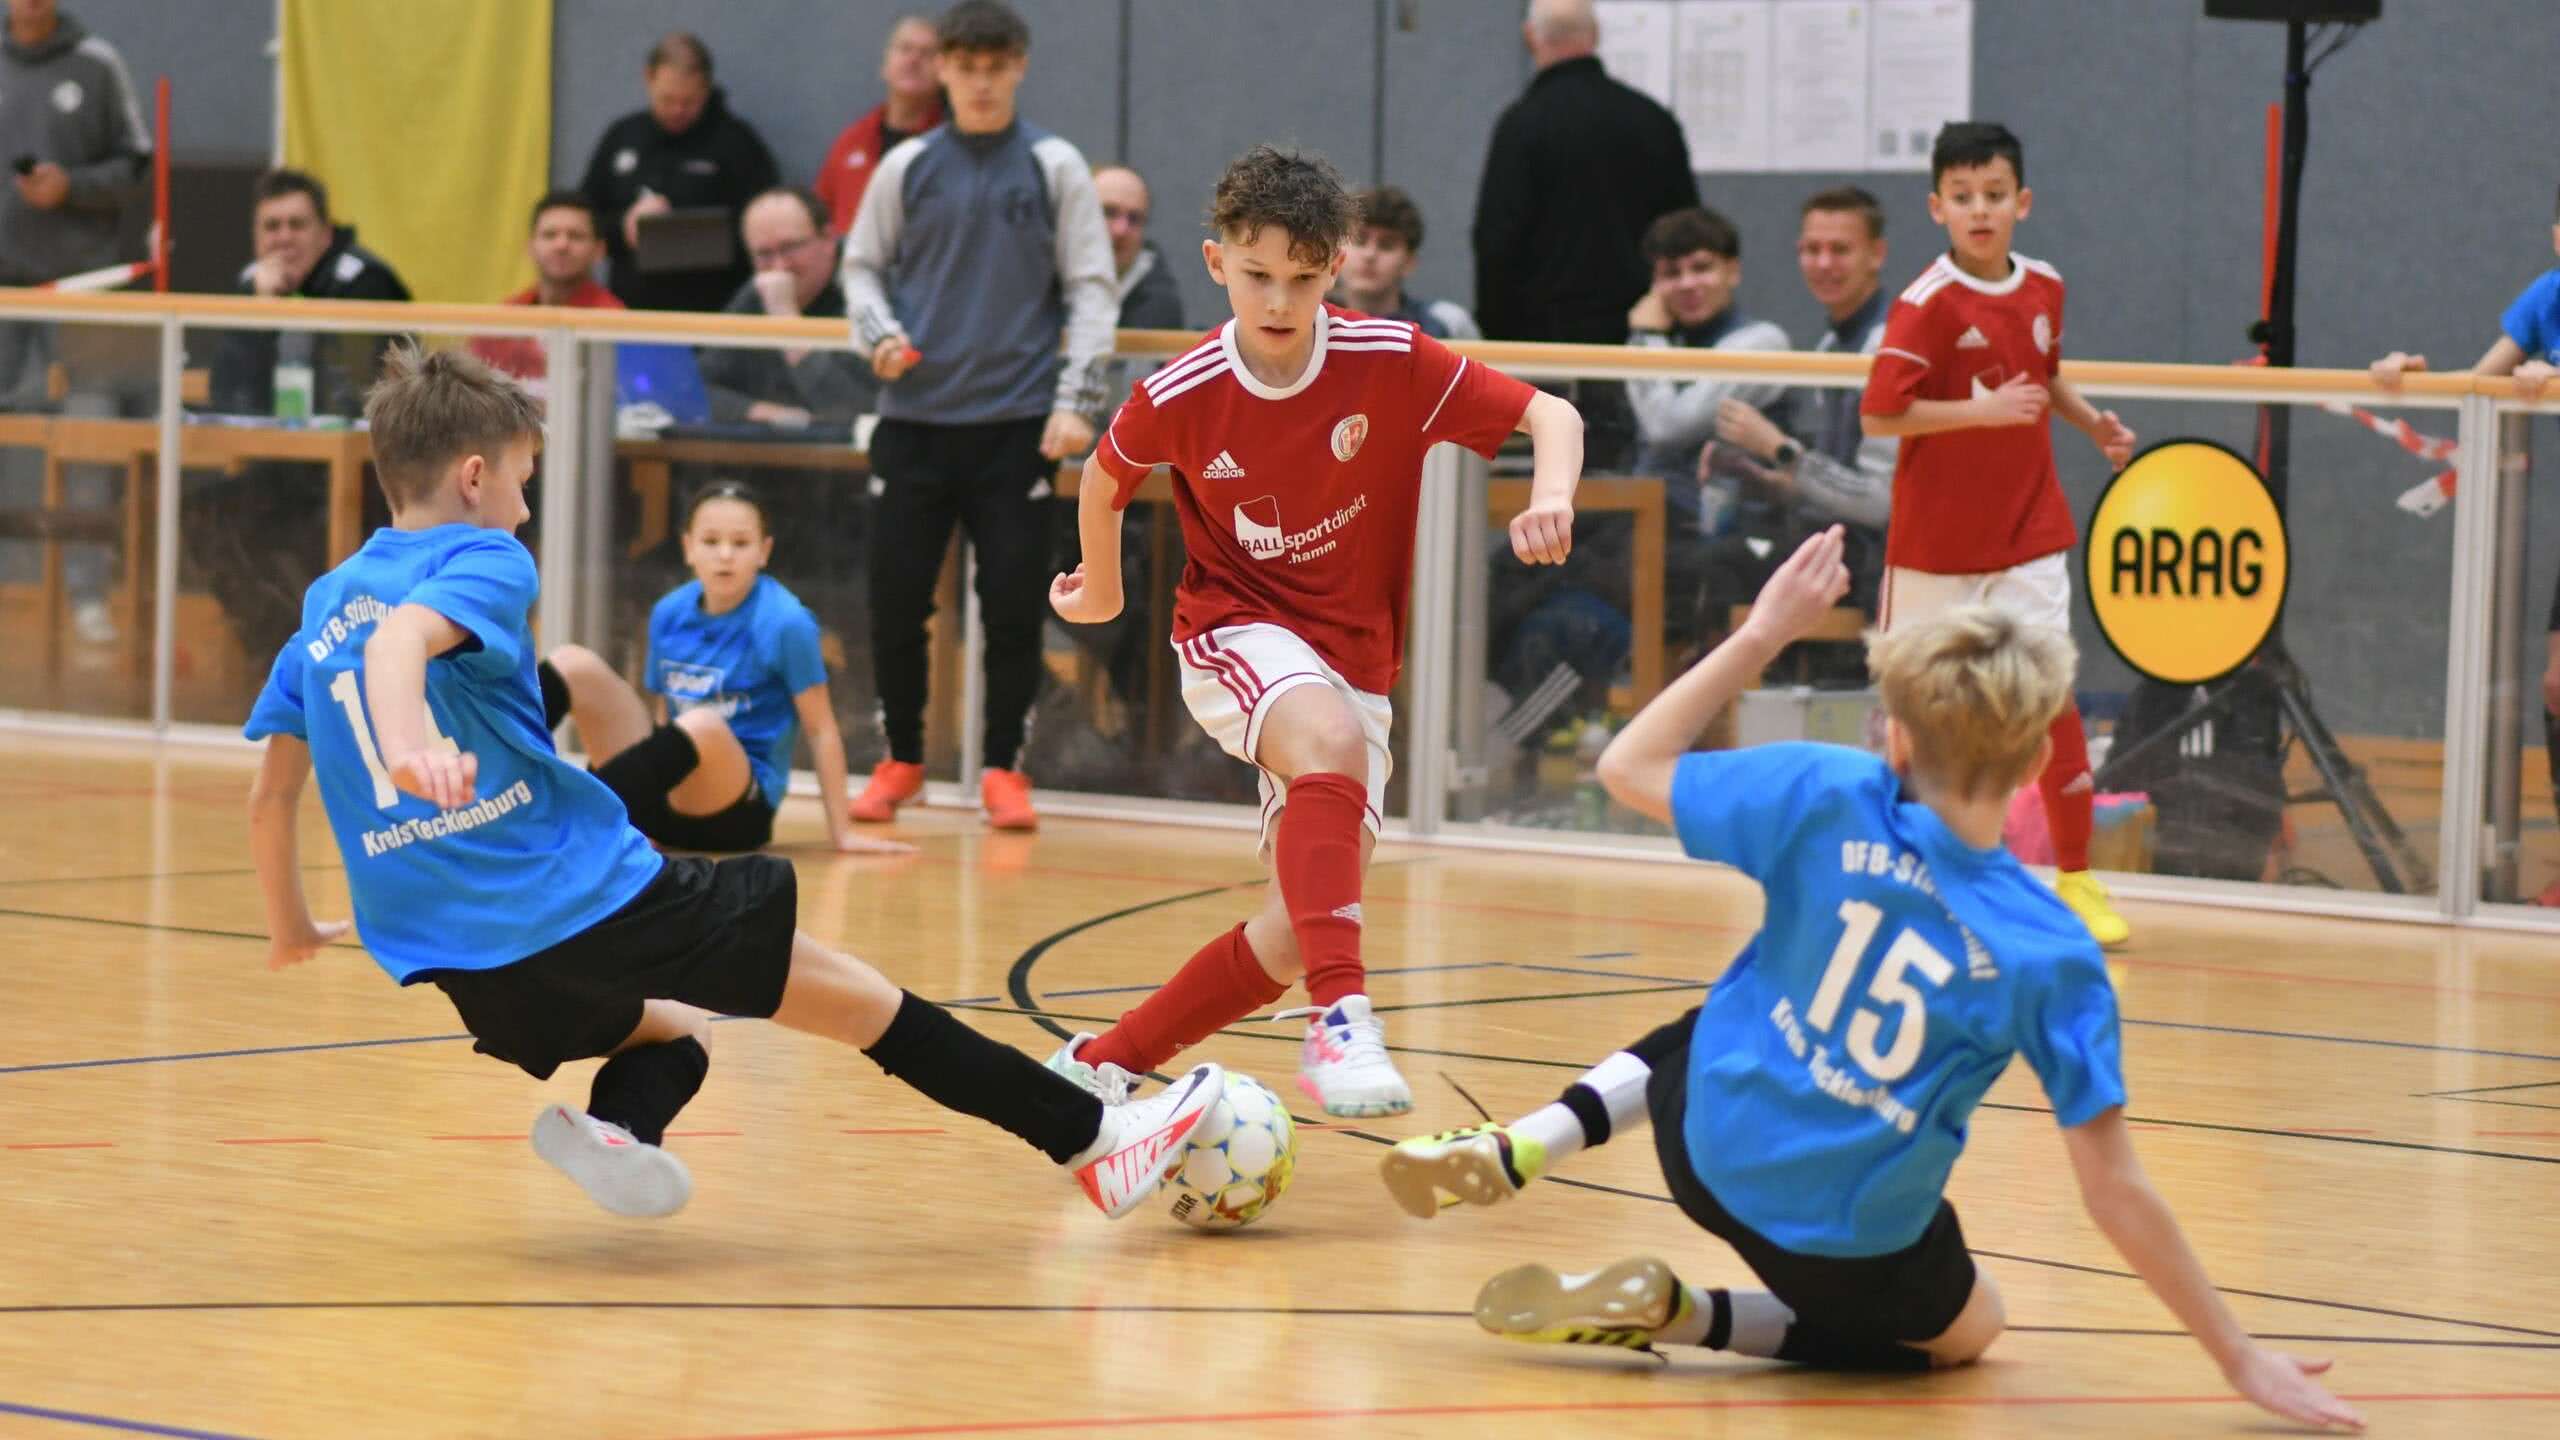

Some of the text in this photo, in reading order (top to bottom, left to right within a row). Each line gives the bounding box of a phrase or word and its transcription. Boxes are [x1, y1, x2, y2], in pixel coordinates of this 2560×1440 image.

[1202, 467, 1246, 479] adidas
[2111, 526, 2263, 598] ARAG
[1805, 898, 1957, 1081] 15
[1093, 1127, 1175, 1217] NIKE
